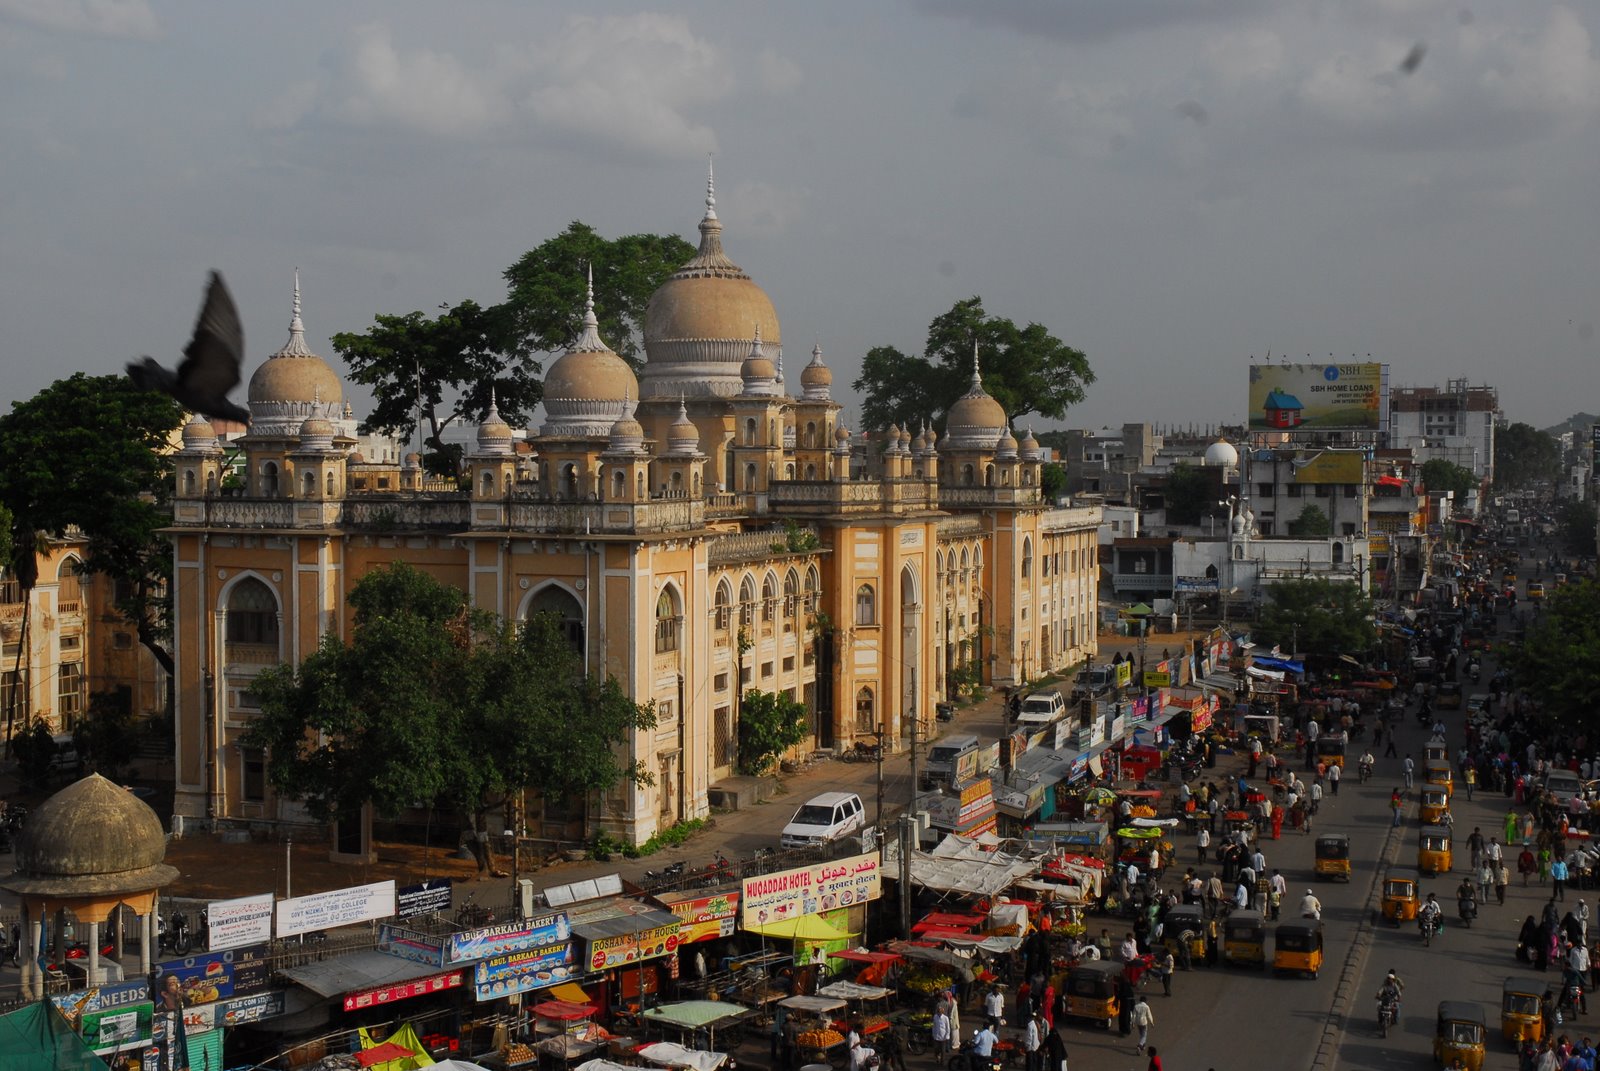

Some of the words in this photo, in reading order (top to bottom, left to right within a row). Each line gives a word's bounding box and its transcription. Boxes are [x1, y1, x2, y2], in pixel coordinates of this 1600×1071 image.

[1340, 366, 1360, 376] SBH
[747, 876, 787, 898] MUQADDAR
[790, 871, 811, 889] HOTEL
[305, 907, 324, 915] NIZAMIA
[342, 899, 367, 909] COLLEGE
[714, 910, 736, 919] Drinks
[460, 932, 483, 942] ABUL
[484, 924, 524, 937] BARKAAT
[526, 916, 555, 930] BAKERY
[593, 936, 624, 952] ROSHAN
[654, 924, 679, 937] HOUSE
[490, 958, 507, 967] ABUL
[508, 952, 539, 963] BARKAAT
[540, 944, 566, 956] BAKERY
[234, 960, 264, 970] COMMUNICATION
[198, 975, 230, 988] PEPSI
[228, 1001, 243, 1009] TELE
[233, 1003, 281, 1022] PEPSI
